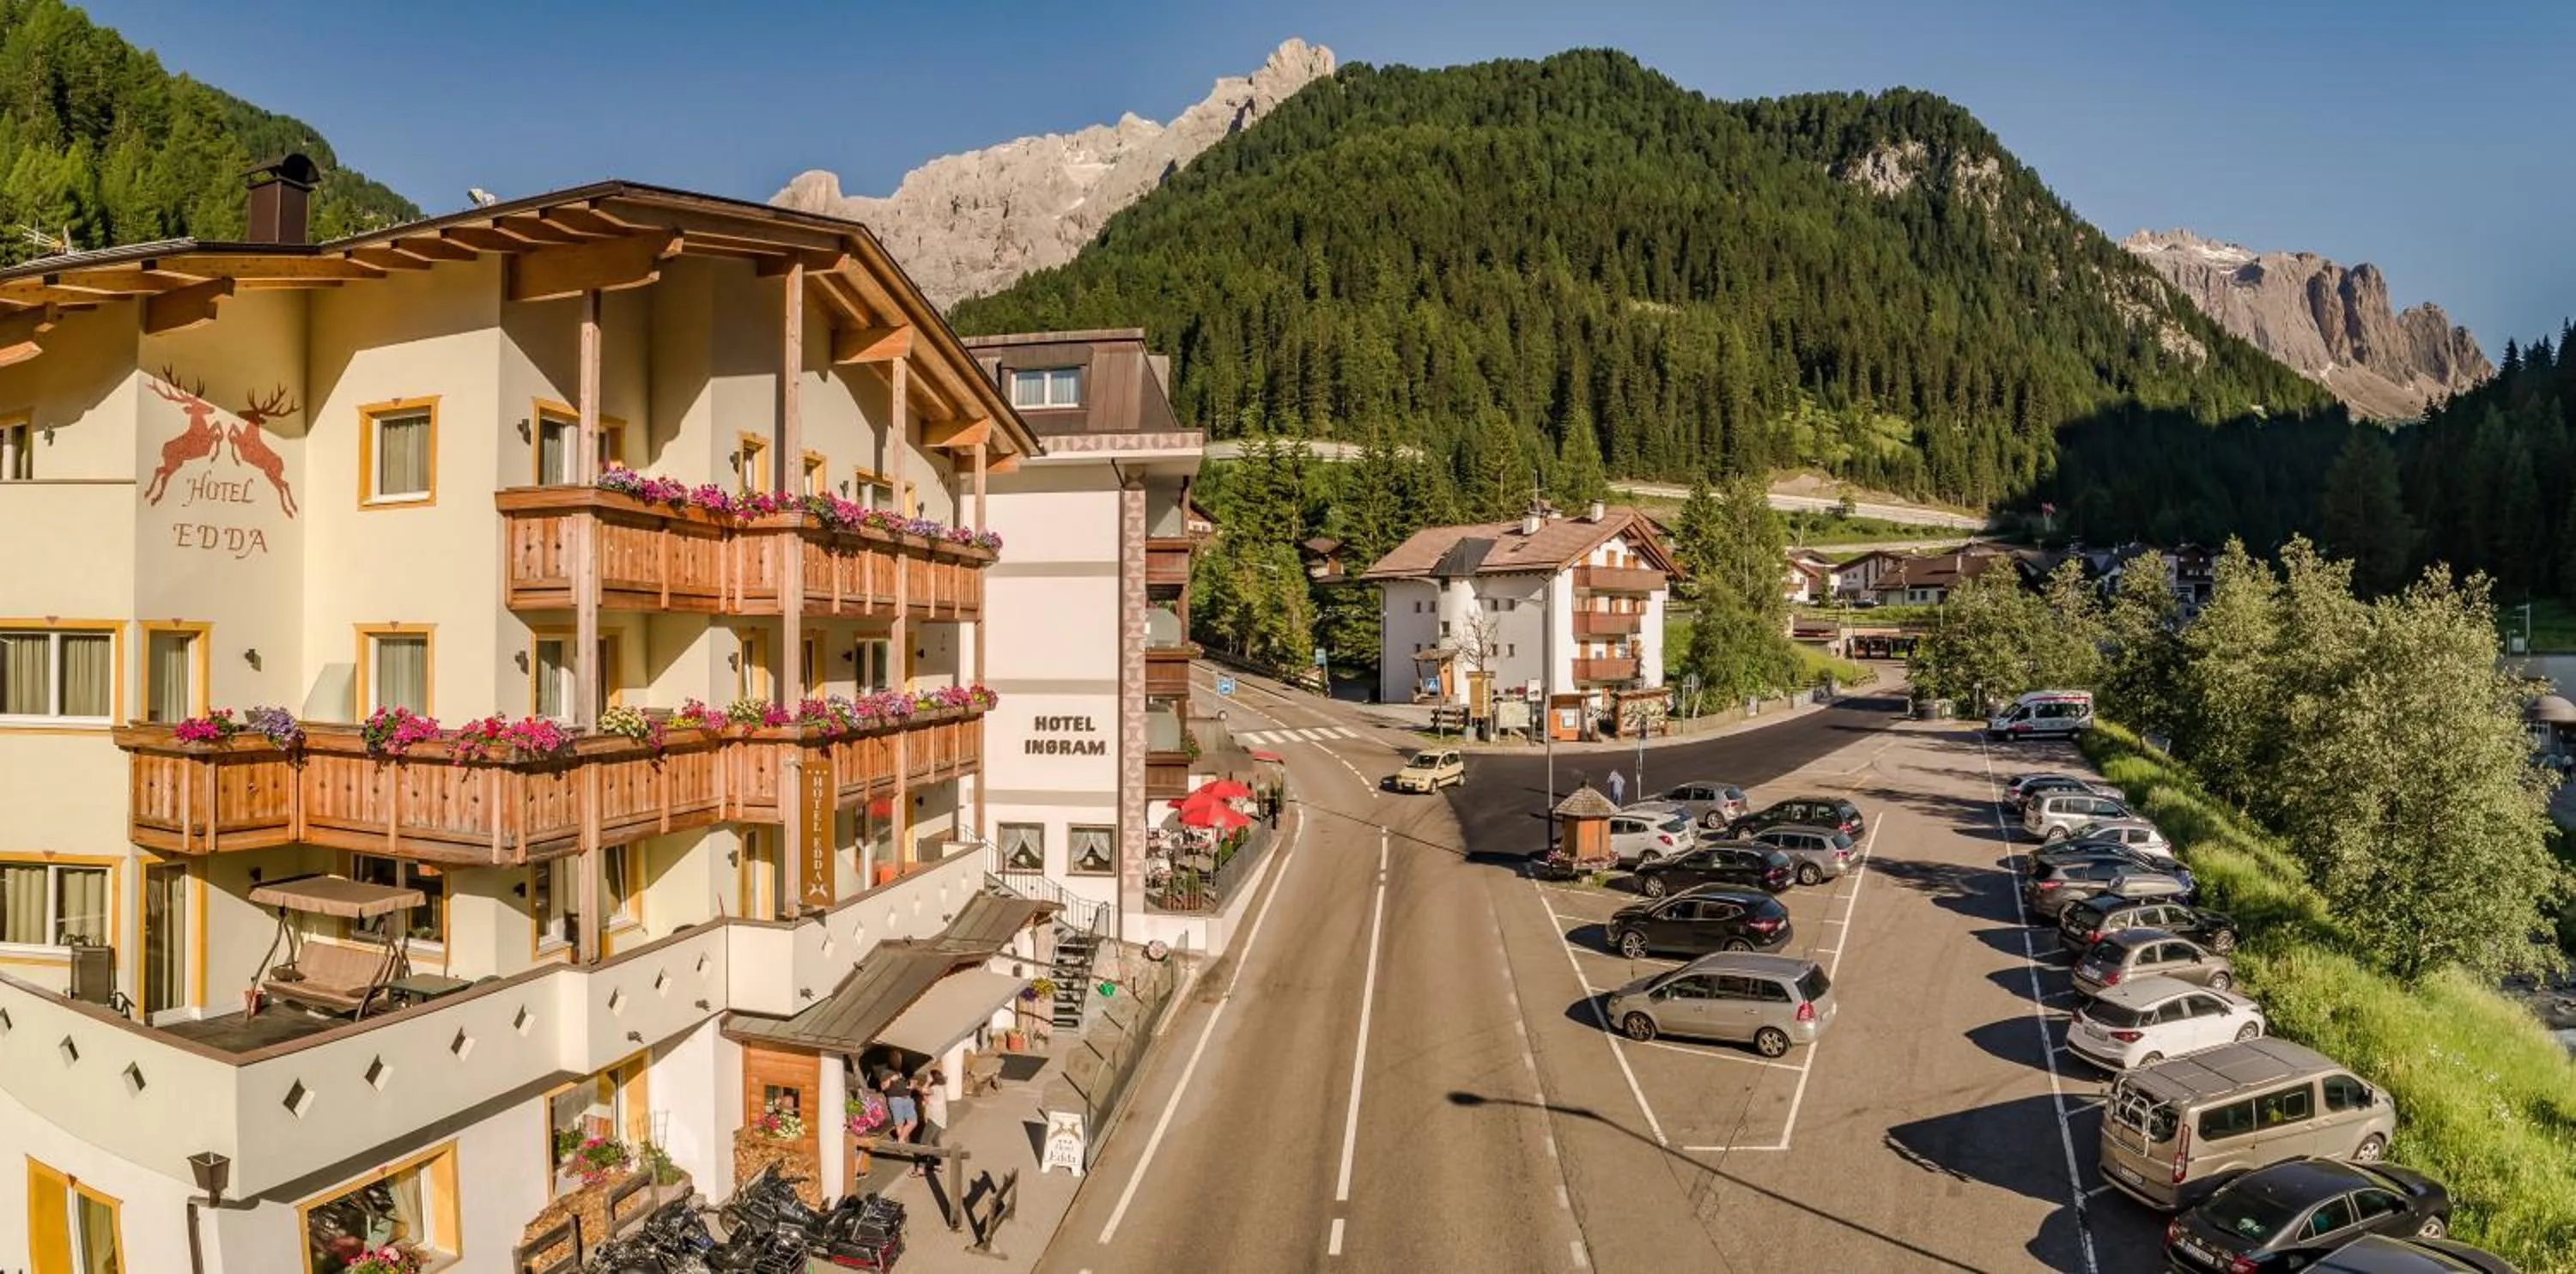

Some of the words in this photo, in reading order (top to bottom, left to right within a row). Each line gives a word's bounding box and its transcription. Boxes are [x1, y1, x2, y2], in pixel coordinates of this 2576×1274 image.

[181, 470, 255, 507] HOTEL
[173, 523, 268, 560] EDDA
[1035, 716, 1096, 731] HOTEL
[1024, 739, 1106, 755] INGRAM
[812, 775, 823, 832] HOTEL
[812, 837, 823, 882] EDDA
